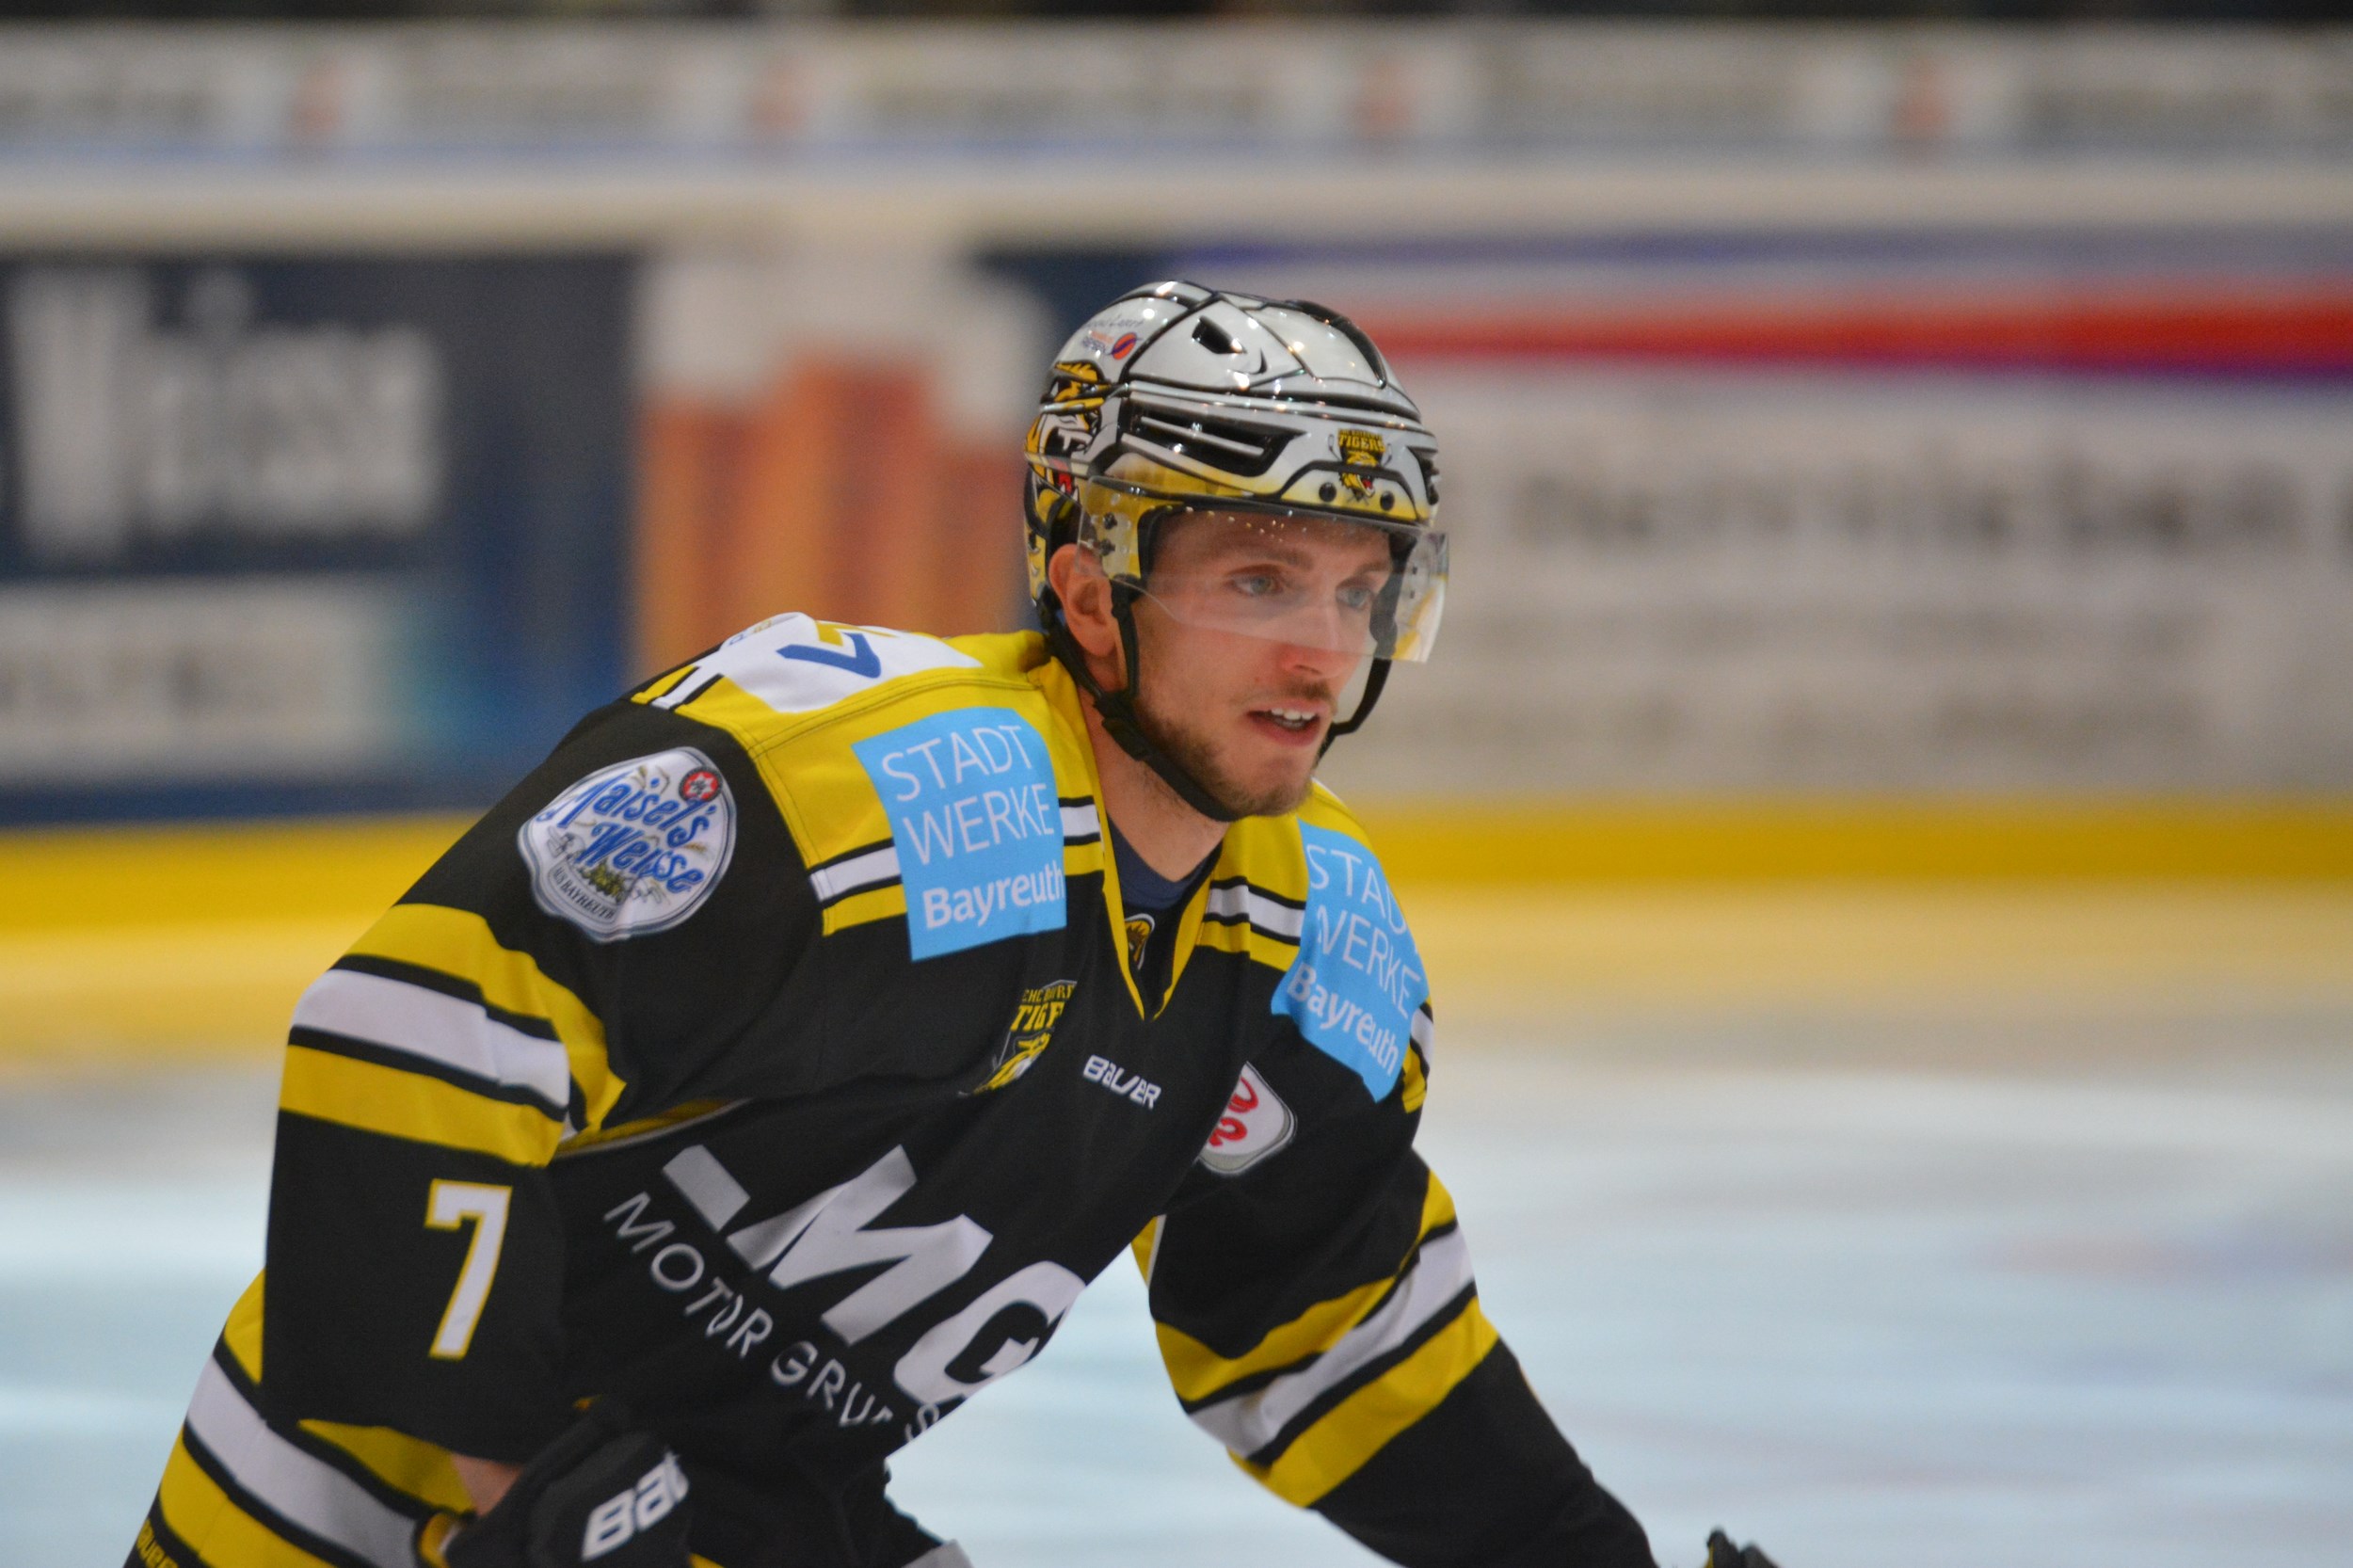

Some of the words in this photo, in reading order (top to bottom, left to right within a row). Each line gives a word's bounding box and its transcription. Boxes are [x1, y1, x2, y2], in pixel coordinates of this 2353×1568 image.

[1338, 432, 1385, 453] TIGERS
[881, 725, 1032, 802] STADT
[536, 769, 717, 848] Maisel's
[902, 783, 1054, 865] WERKE
[922, 859, 1064, 930] Bayreuth
[1288, 962, 1400, 1076] Bayreuth
[1082, 1055, 1161, 1110] BAUER
[424, 1178, 512, 1360] 7
